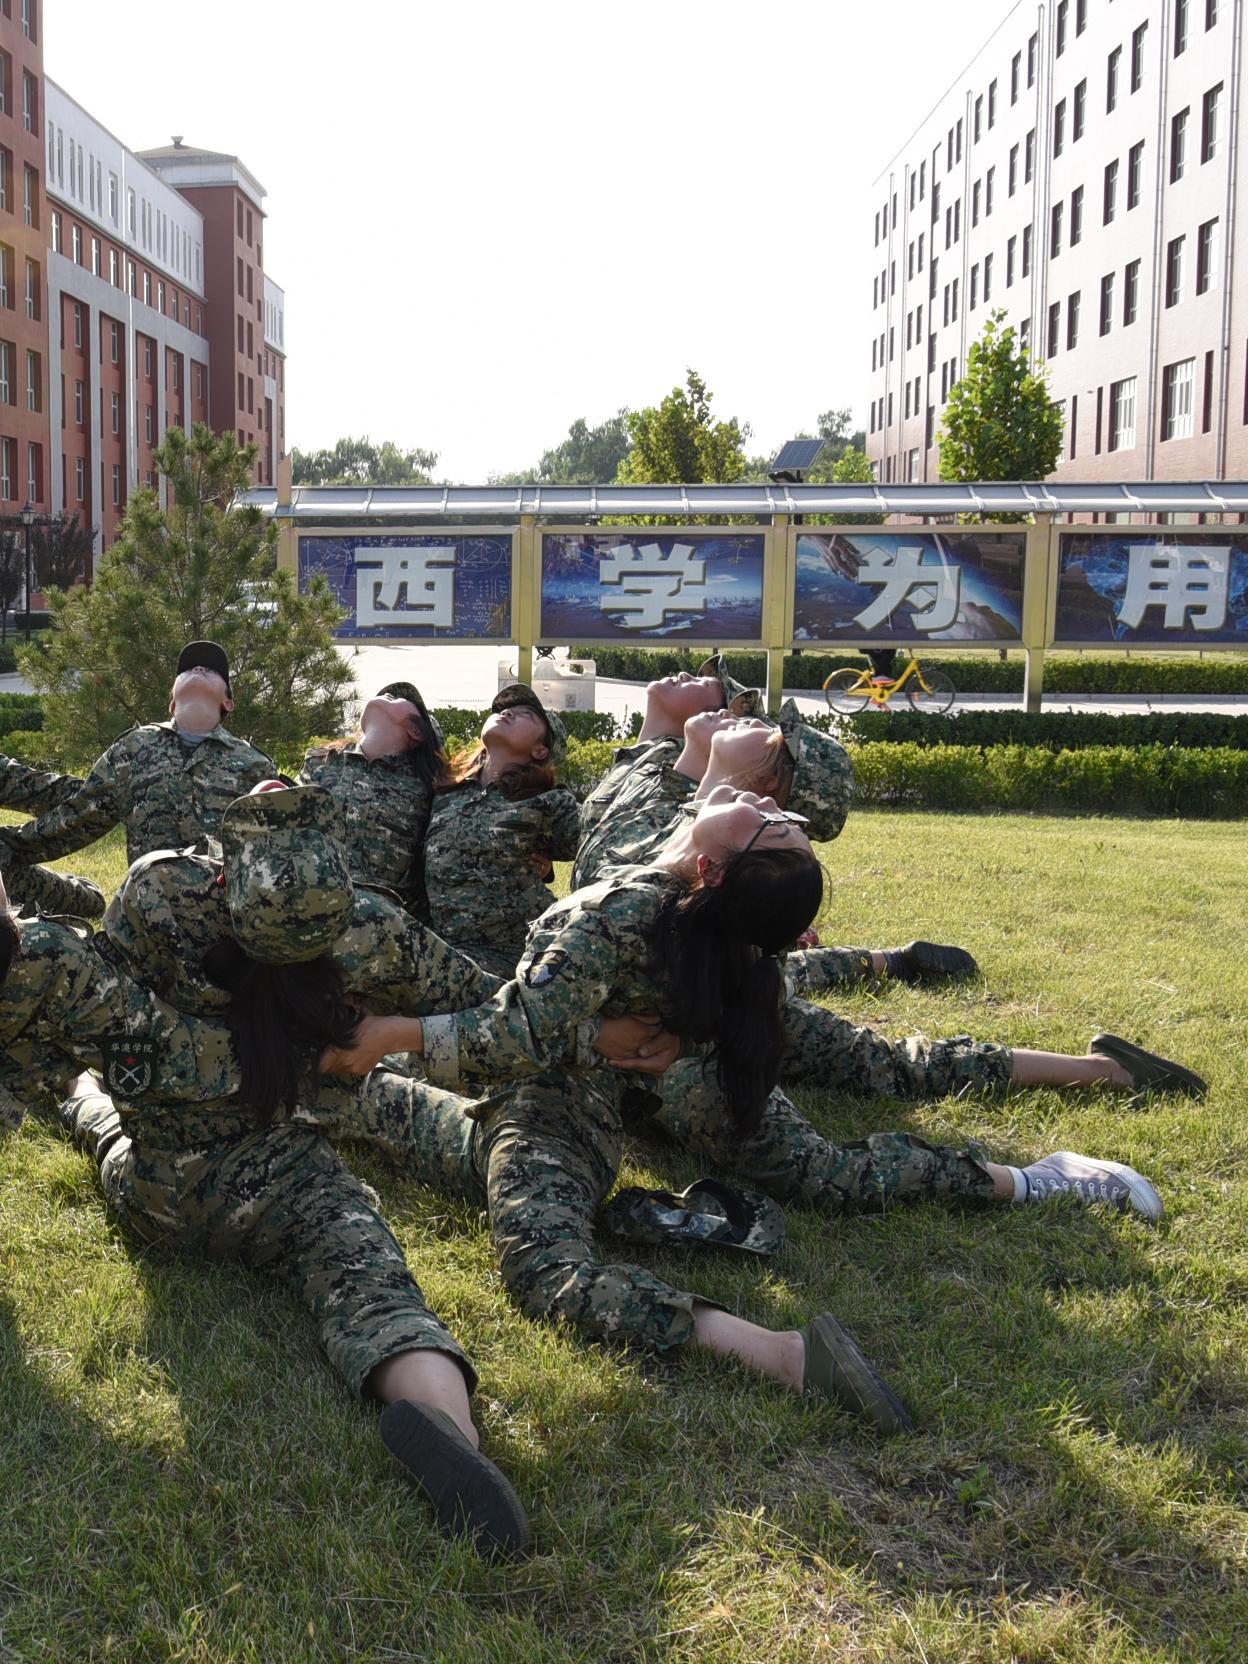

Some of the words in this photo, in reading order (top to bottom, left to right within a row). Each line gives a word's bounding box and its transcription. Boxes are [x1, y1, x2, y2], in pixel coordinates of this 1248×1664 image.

[354, 546, 457, 629] 西
[599, 543, 707, 630] 学
[853, 546, 961, 632] 为
[1115, 545, 1233, 632] 用
[110, 1042, 153, 1054] 华澳学院
